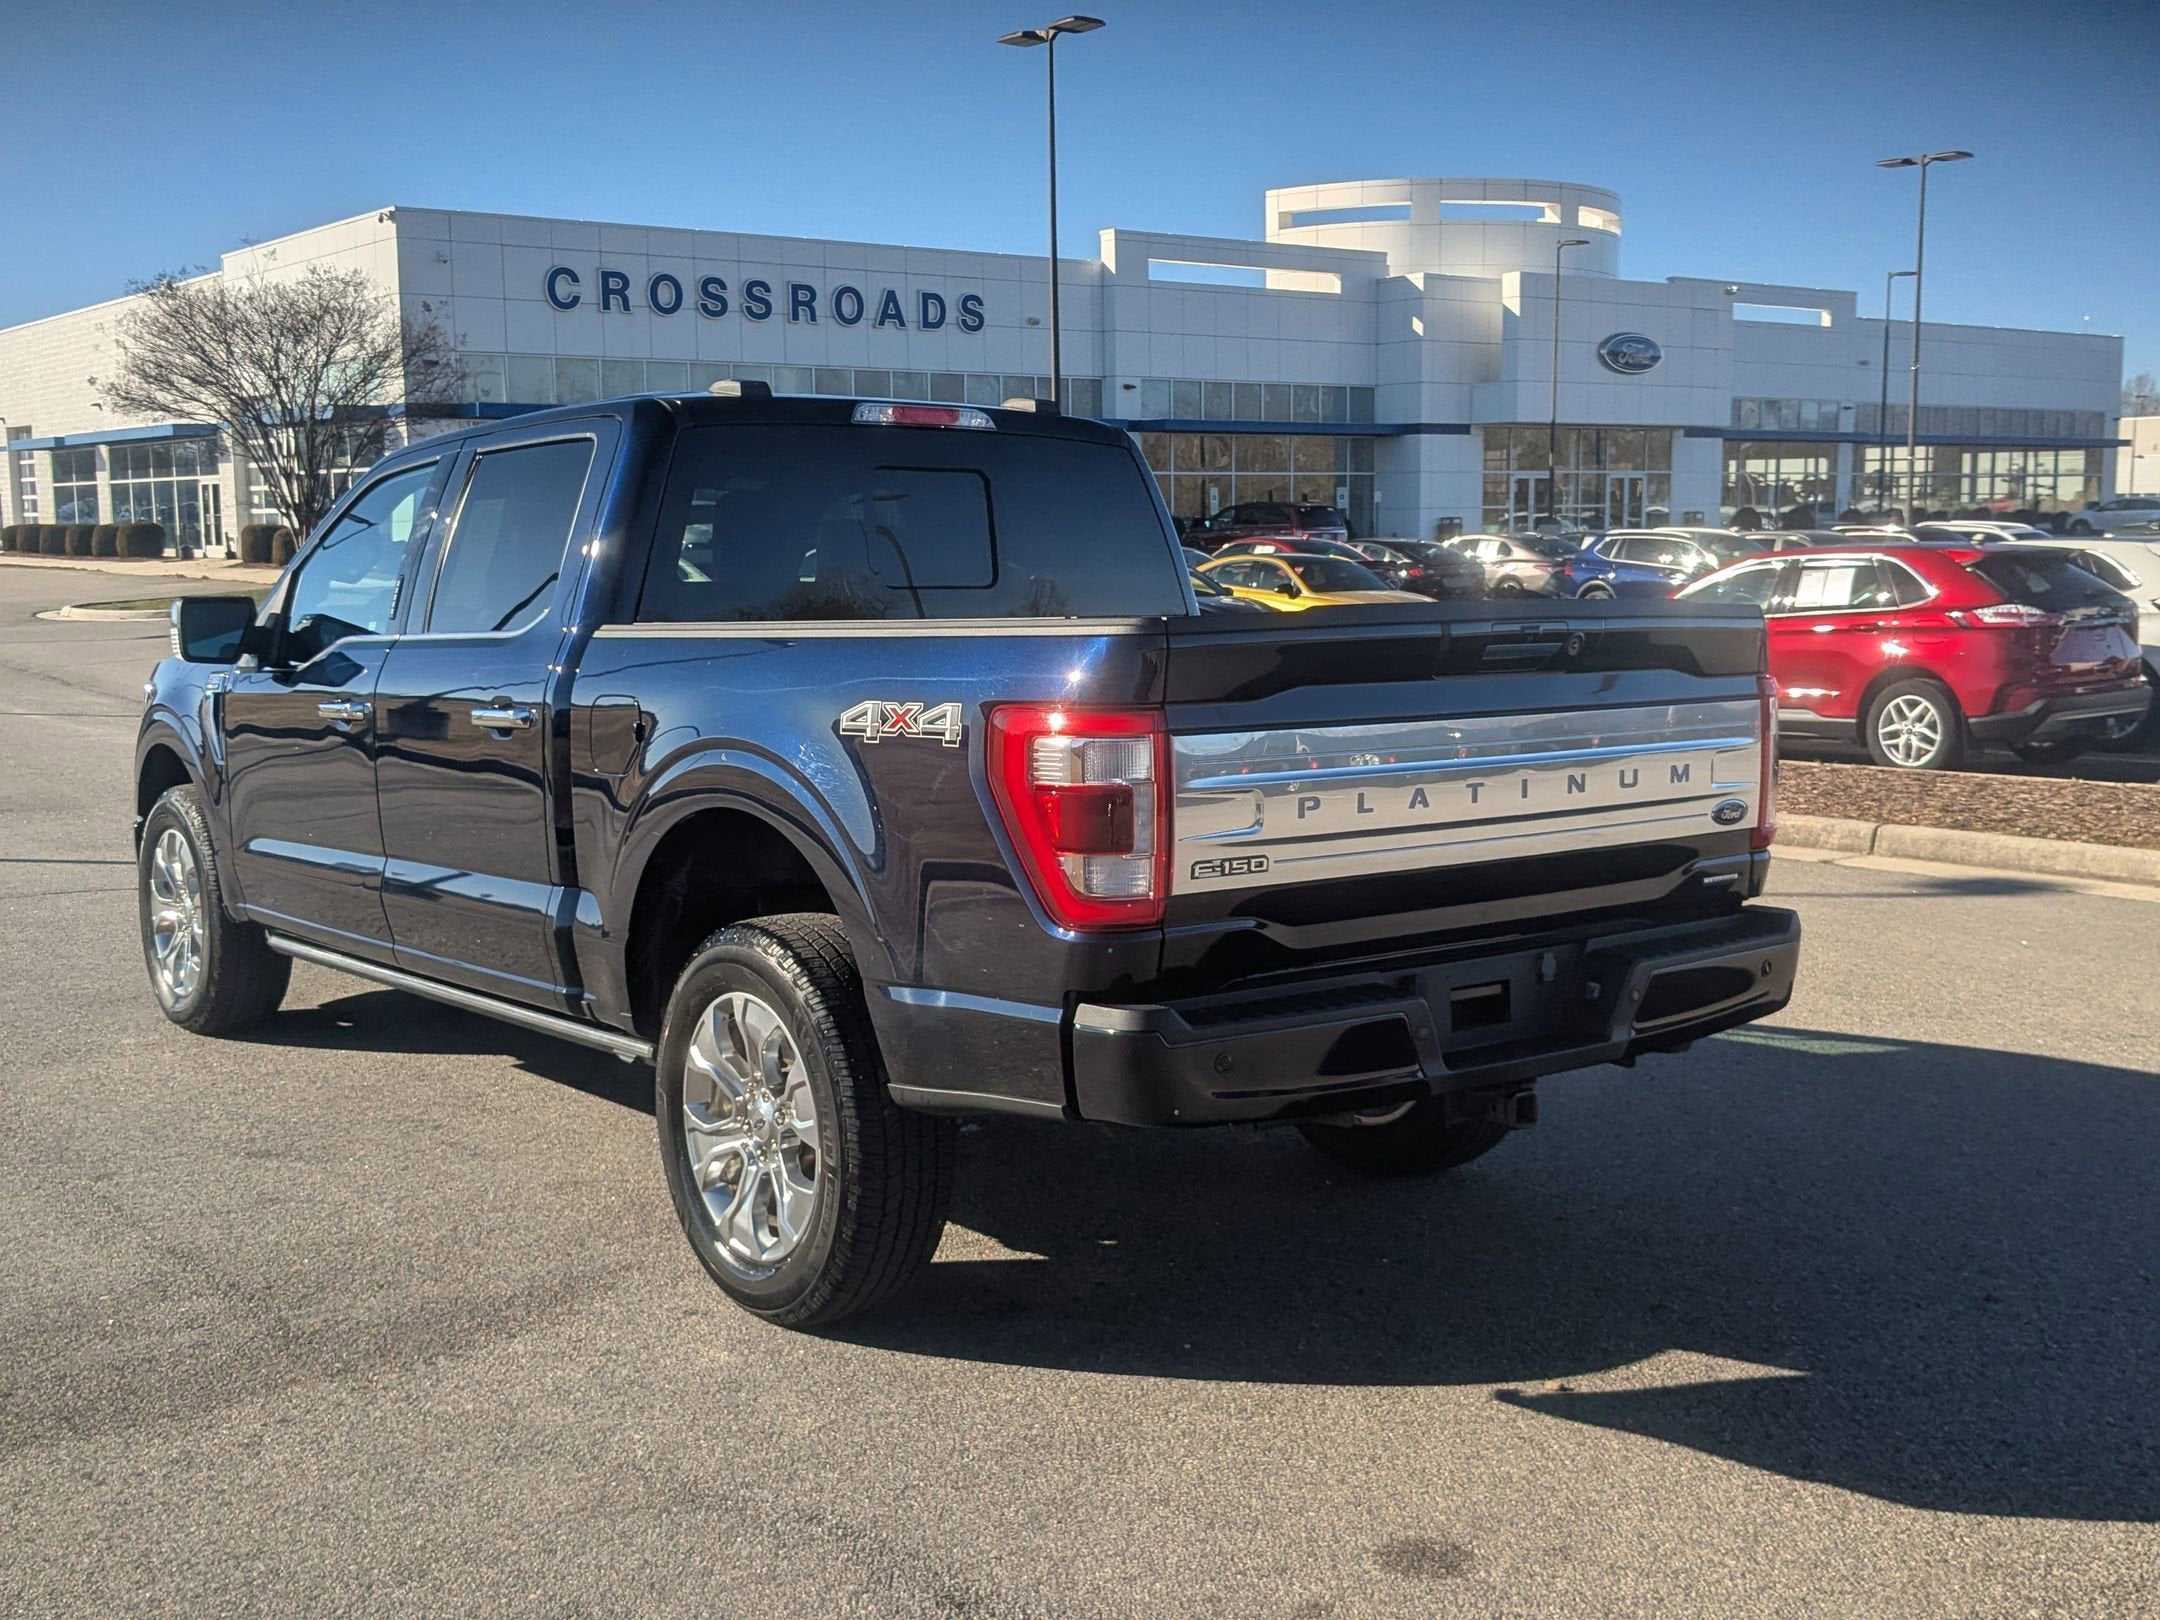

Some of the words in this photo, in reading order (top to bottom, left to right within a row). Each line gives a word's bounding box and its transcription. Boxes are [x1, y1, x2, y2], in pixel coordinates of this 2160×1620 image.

[545, 265, 986, 334] CROSSROADS
[1297, 763, 1690, 819] PLATINUM
[1191, 855, 1269, 880] F-150
